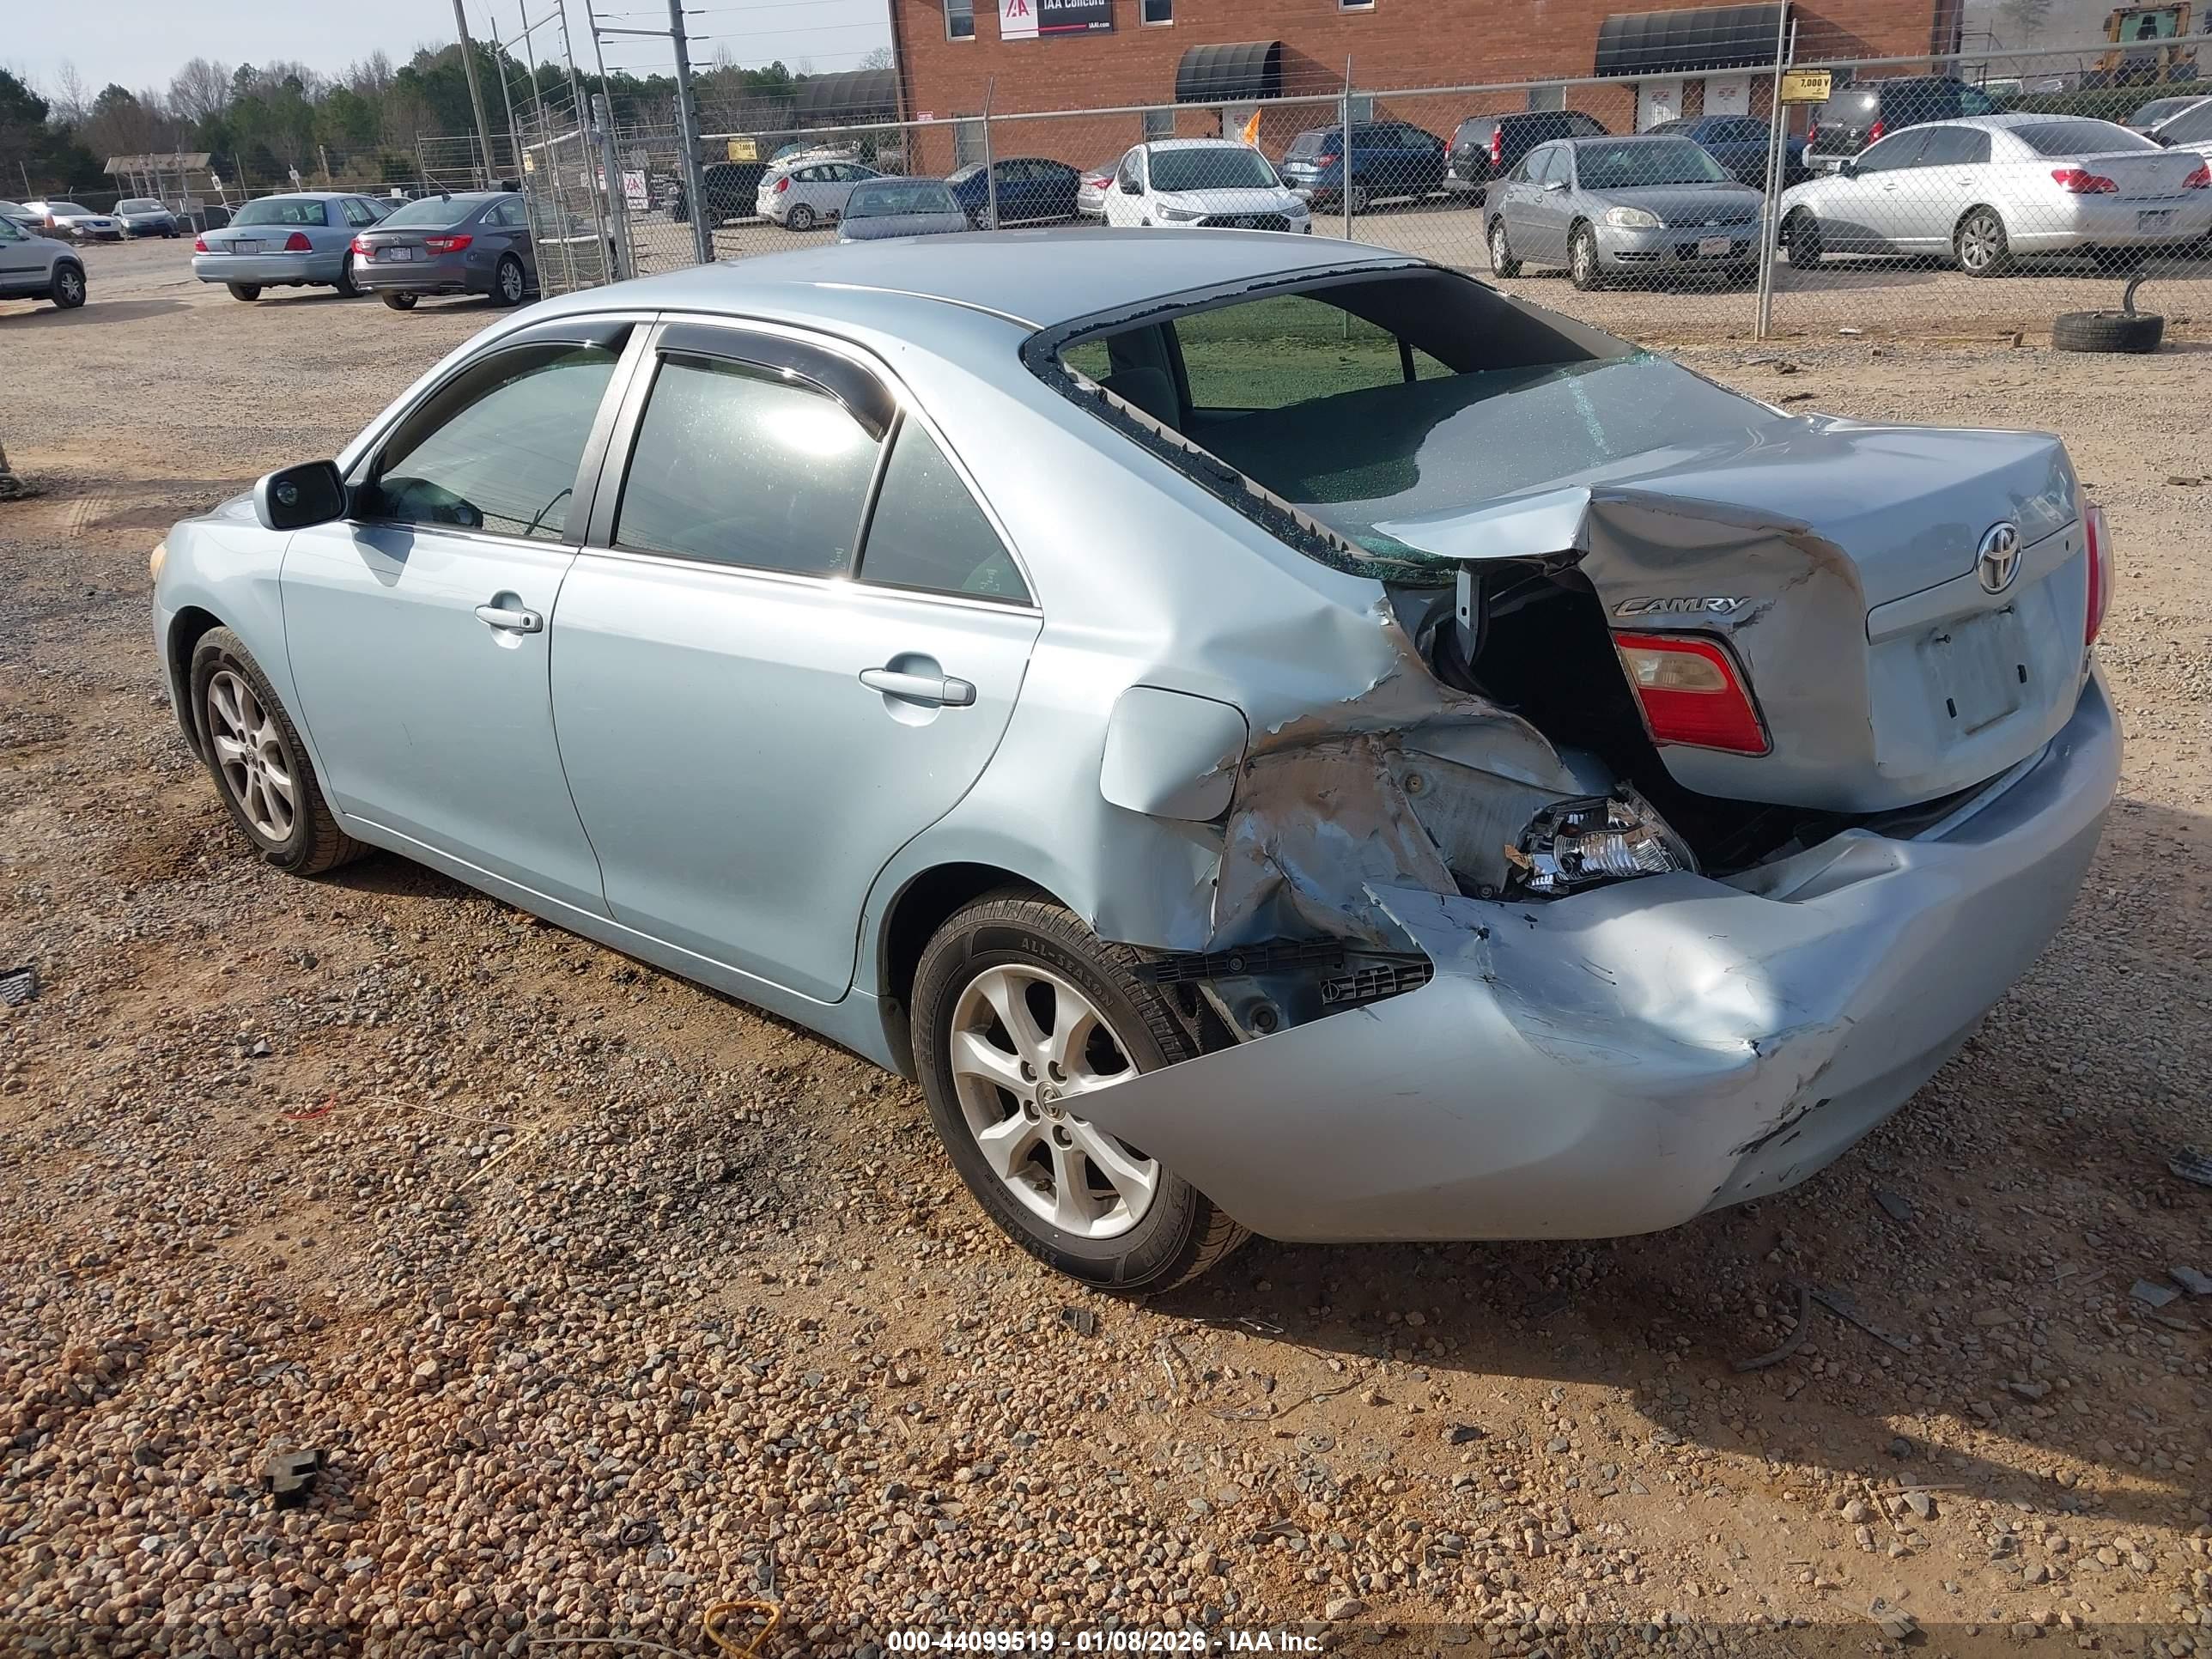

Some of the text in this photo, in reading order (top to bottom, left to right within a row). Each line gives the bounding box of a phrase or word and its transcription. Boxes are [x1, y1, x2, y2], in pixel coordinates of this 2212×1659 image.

[1043, 0, 1063, 10] IAA
[1800, 78, 1830, 88] 7,000 V
[1613, 596, 1753, 617] CAMRY
[1021, 938, 1114, 1007] ALL-SEASON
